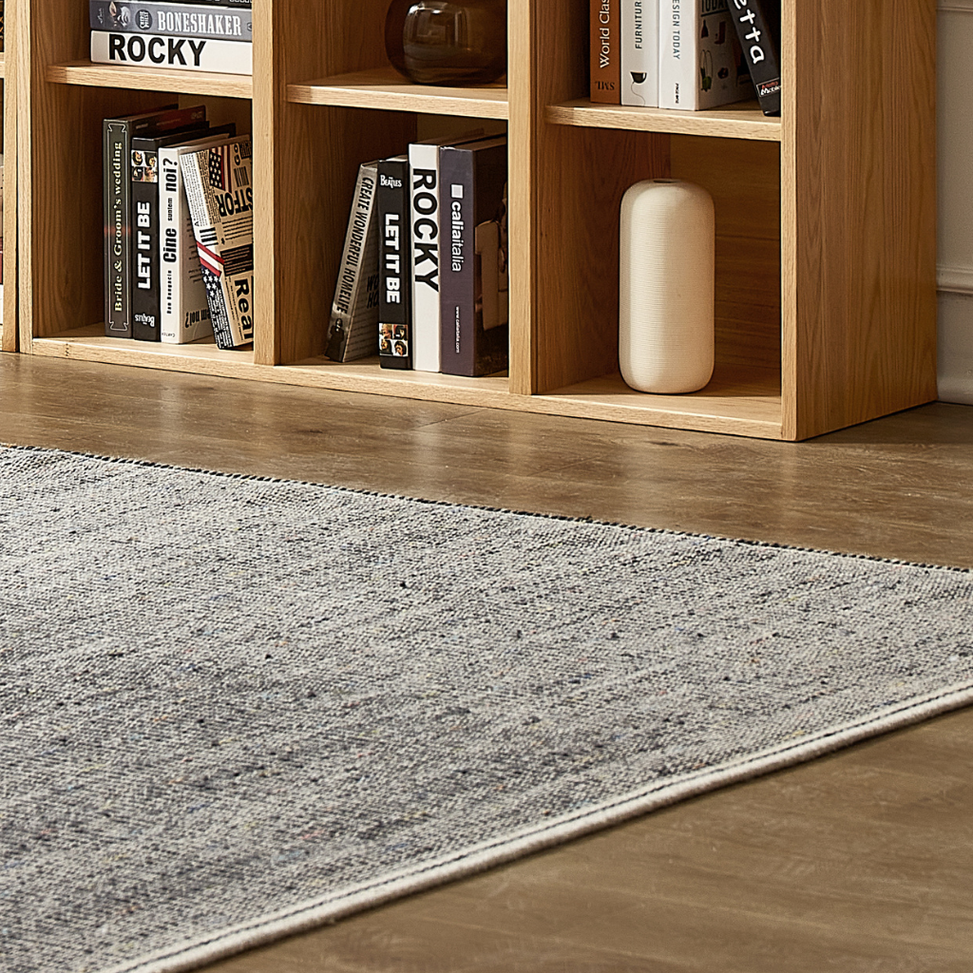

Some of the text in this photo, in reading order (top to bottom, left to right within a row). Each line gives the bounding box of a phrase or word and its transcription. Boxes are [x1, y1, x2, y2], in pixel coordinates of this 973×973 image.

[157, 11, 242, 36] BONESHAKER
[599, 27, 610, 69] World
[672, 30, 681, 60] TODAY
[109, 33, 207, 67] ROCKY
[163, 157, 178, 193] noi?
[113, 142, 123, 313] Bride & Groom's wedding
[137, 202, 151, 290] LET IT BE
[163, 228, 177, 263] Cine
[336, 176, 375, 315] CREATE WONDERFUL HOMELIFE
[412, 168, 440, 293] ROCKY
[384, 213, 401, 304] LET IT BE
[234, 278, 254, 340] Real
